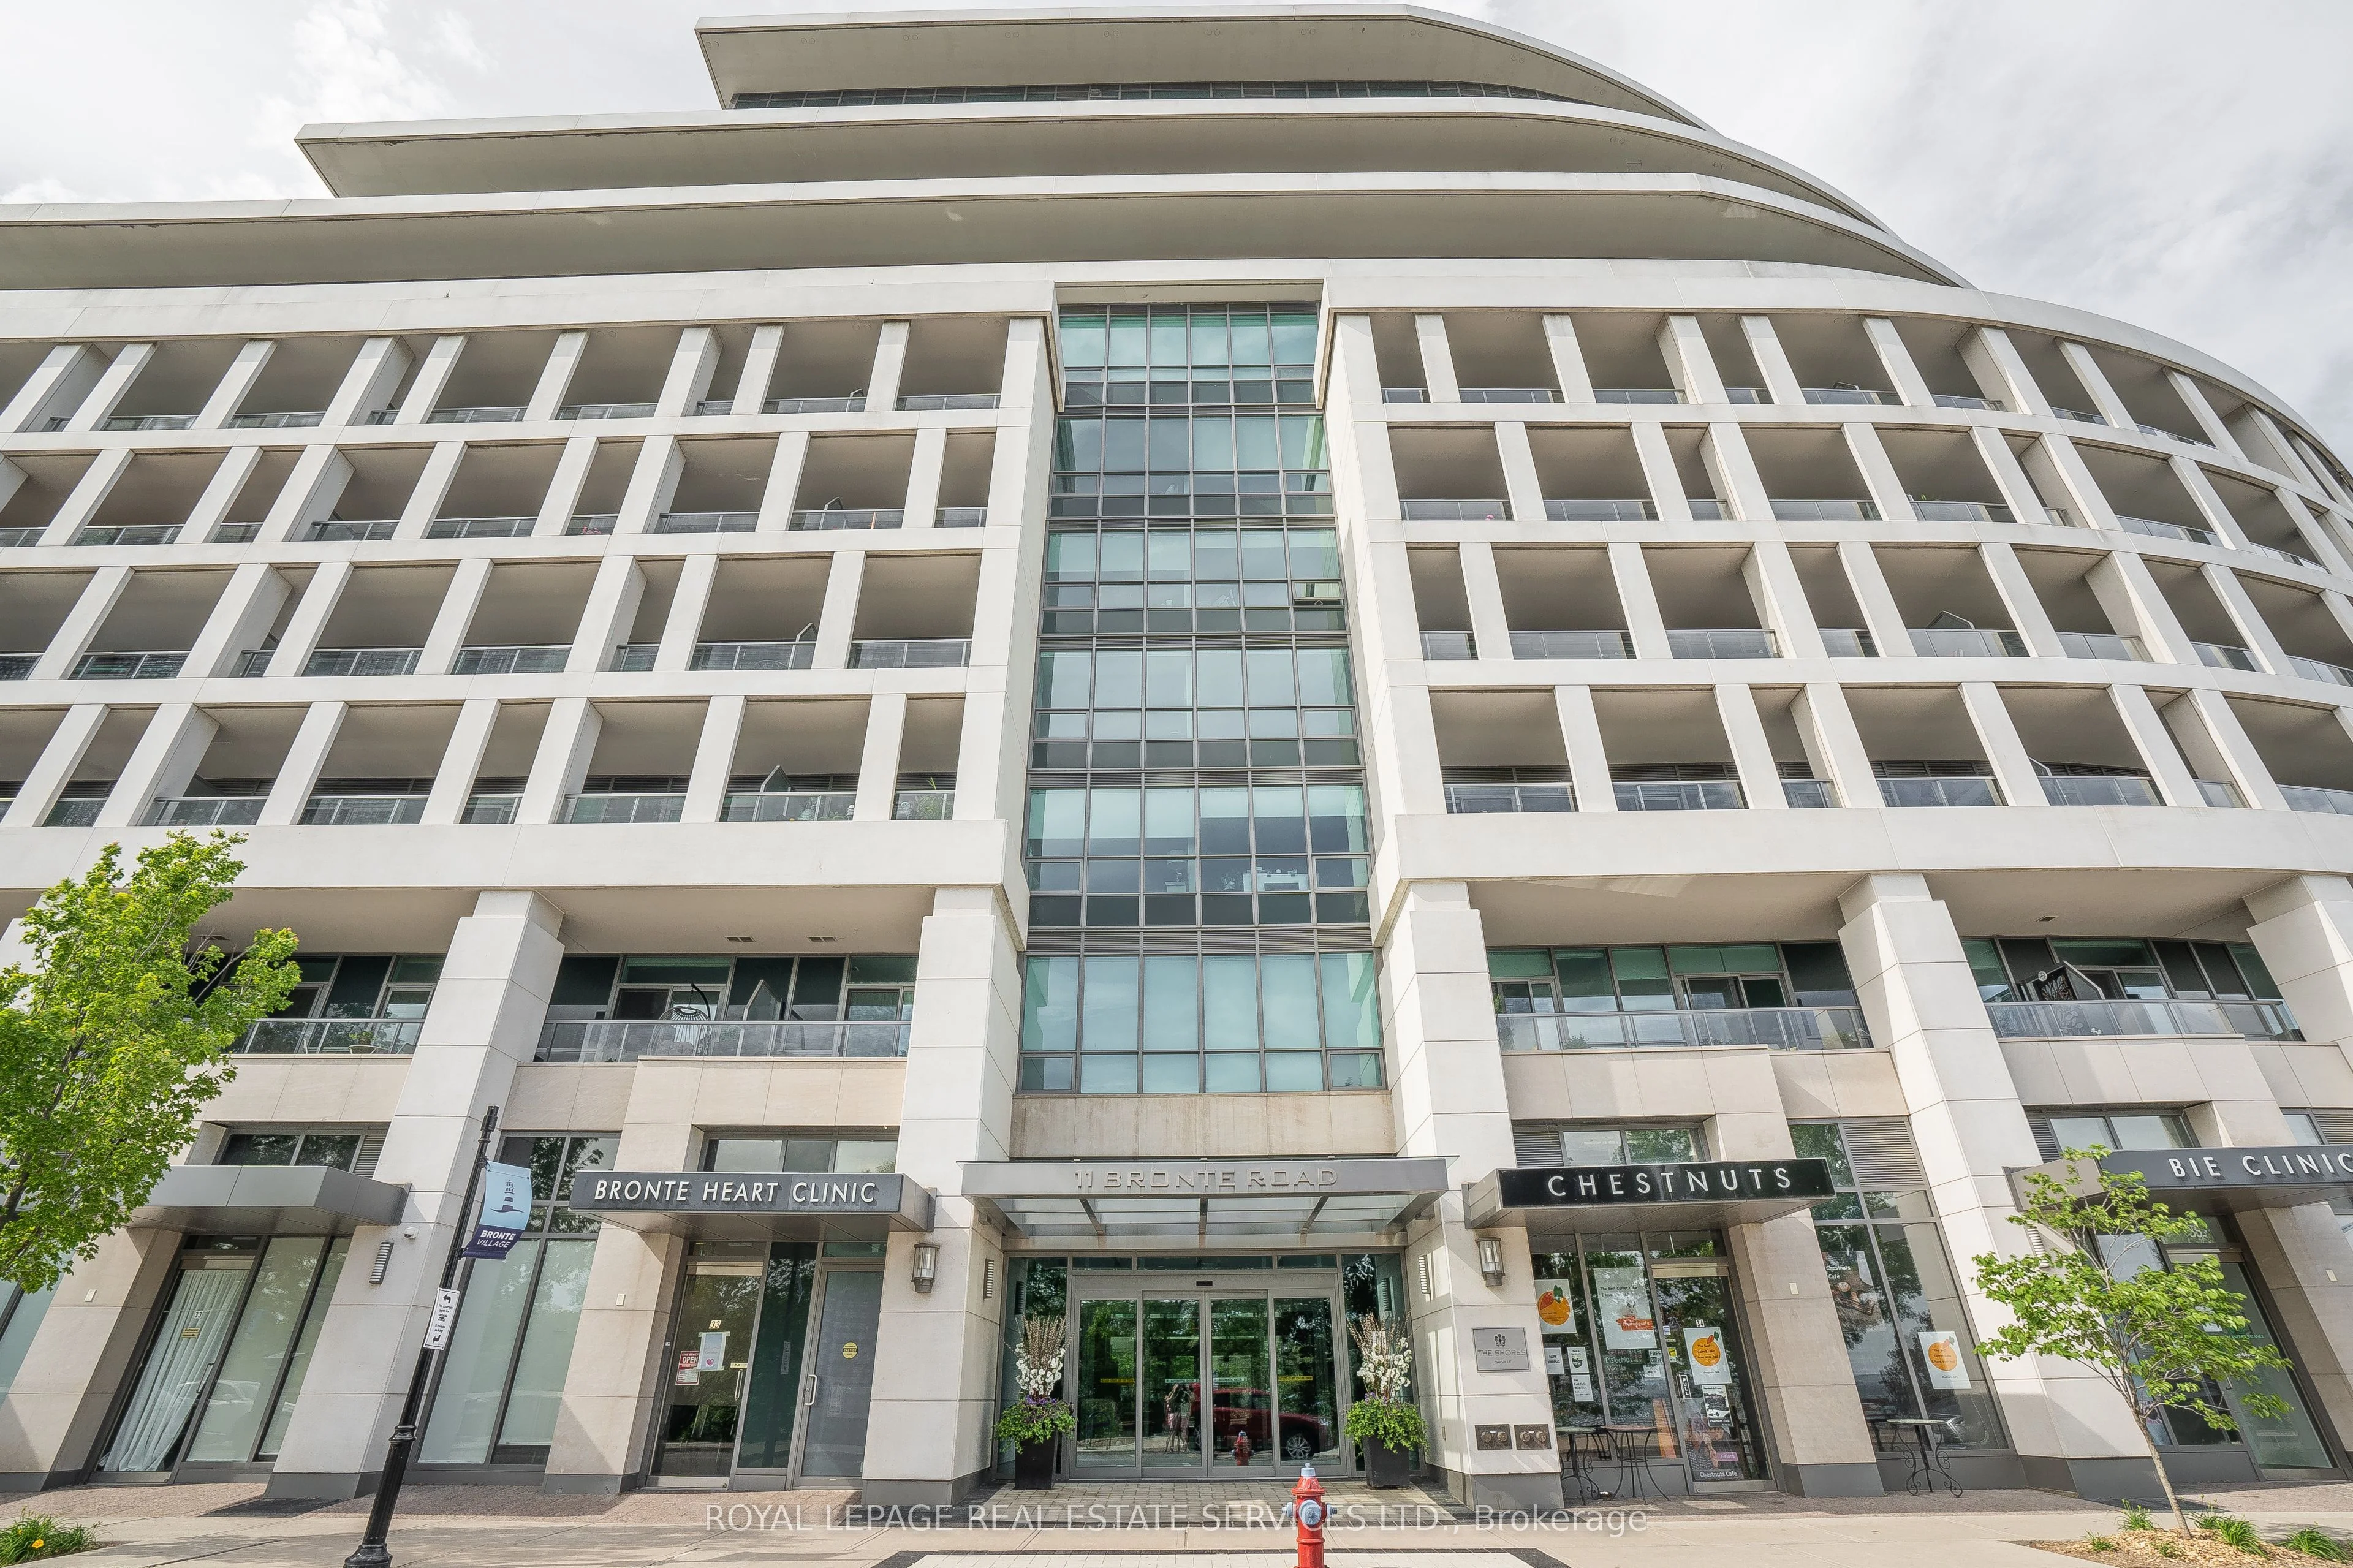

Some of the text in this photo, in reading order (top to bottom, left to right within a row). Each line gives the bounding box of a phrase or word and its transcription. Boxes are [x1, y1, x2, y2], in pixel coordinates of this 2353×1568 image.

[2168, 1153, 2353, 1177] BIE CLINIC
[1074, 1167, 1338, 1187] 11 BRONTE ROAD
[1547, 1168, 1790, 1197] CHESTNUTS
[594, 1180, 877, 1203] BRONTE HEART CLINIC
[477, 1239, 511, 1248] VILLAGE
[480, 1230, 516, 1240] BRONTE
